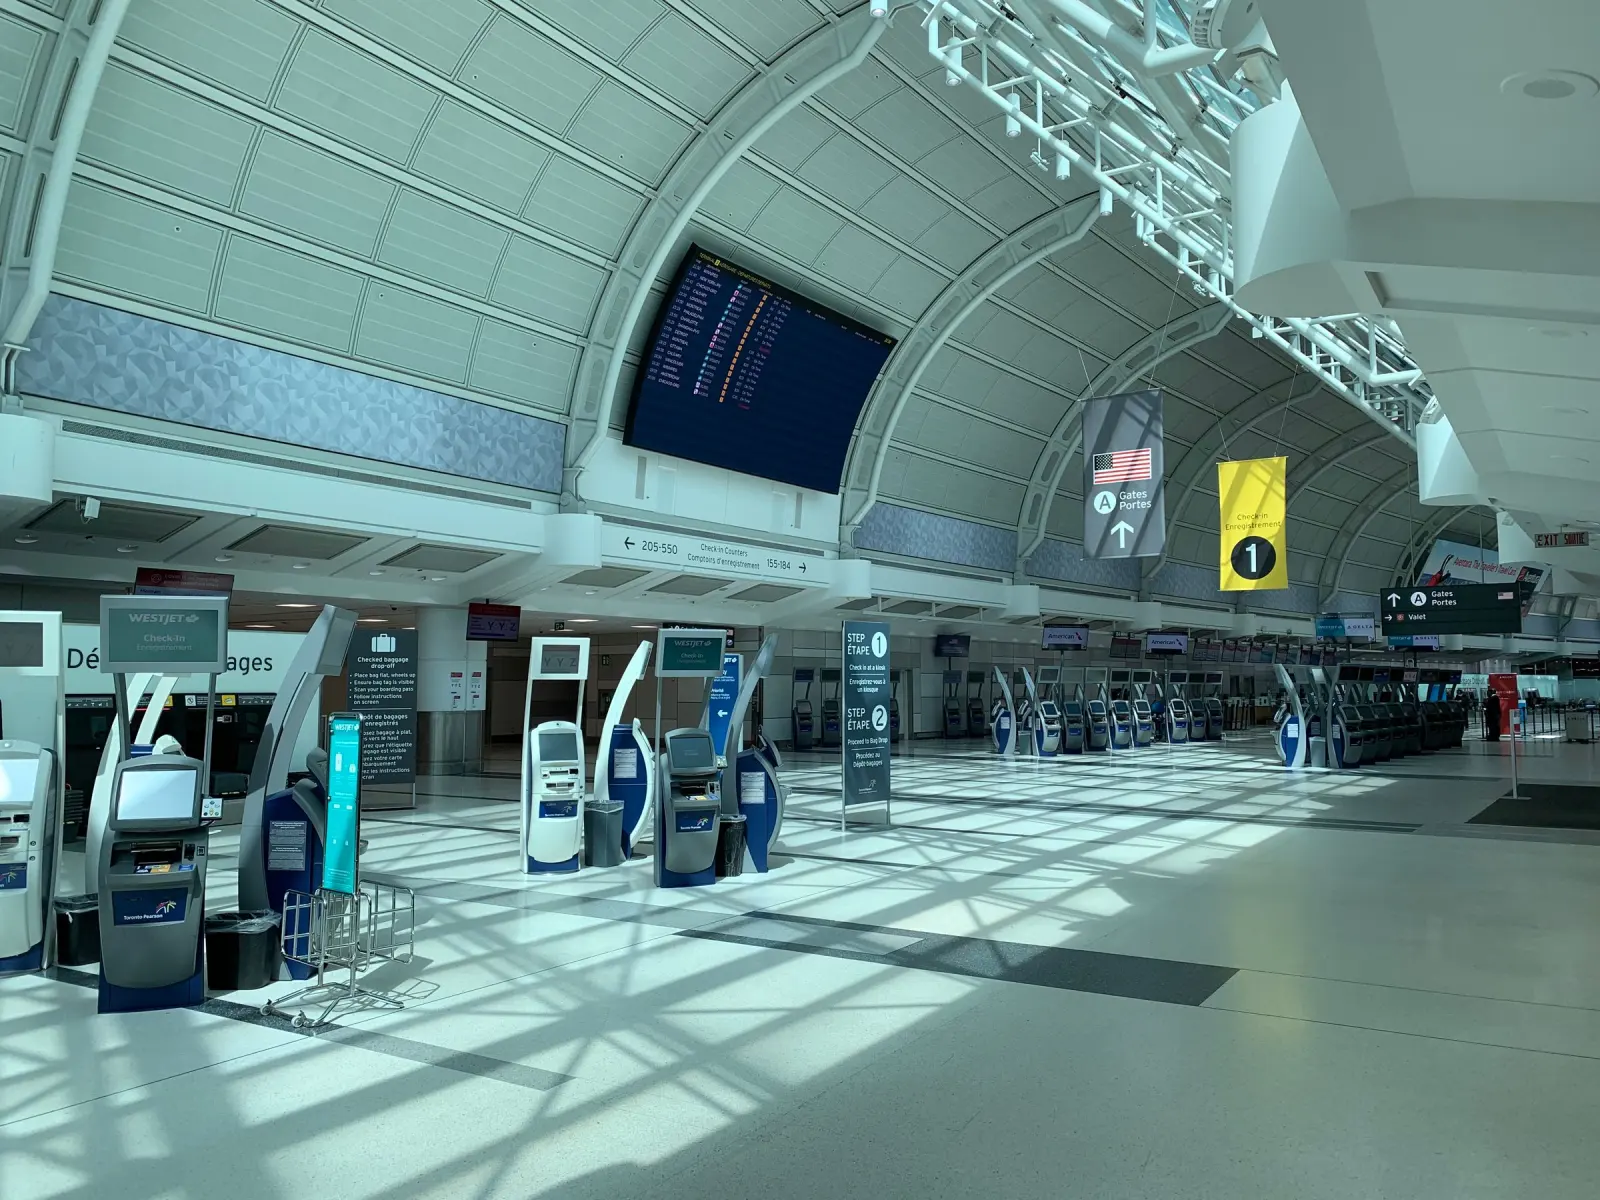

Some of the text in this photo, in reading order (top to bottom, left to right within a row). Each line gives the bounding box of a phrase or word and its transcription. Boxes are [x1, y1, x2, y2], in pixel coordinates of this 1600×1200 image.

[1119, 490, 1148, 500] Gates
[1099, 494, 1111, 510] A
[1120, 500, 1152, 511] Portes
[1225, 521, 1281, 531] Enregistrement
[1538, 534, 1558, 546] EXIT
[642, 540, 678, 555] 205-550
[701, 544, 748, 557] Check-in Counters
[688, 554, 760, 570] Comptoirs d'enregistrement
[1246, 543, 1257, 572] 1
[767, 559, 790, 570] 155-184
[1414, 594, 1423, 604] A
[1431, 598, 1457, 606] Portes
[129, 614, 185, 625] WESTJET
[848, 633, 865, 642] STEP
[674, 640, 704, 648] WESTJET
[848, 643, 870, 655] ÉTAPE
[848, 708, 866, 718] STEP
[876, 708, 884, 727] 2
[848, 718, 870, 730] ÉTAPE
